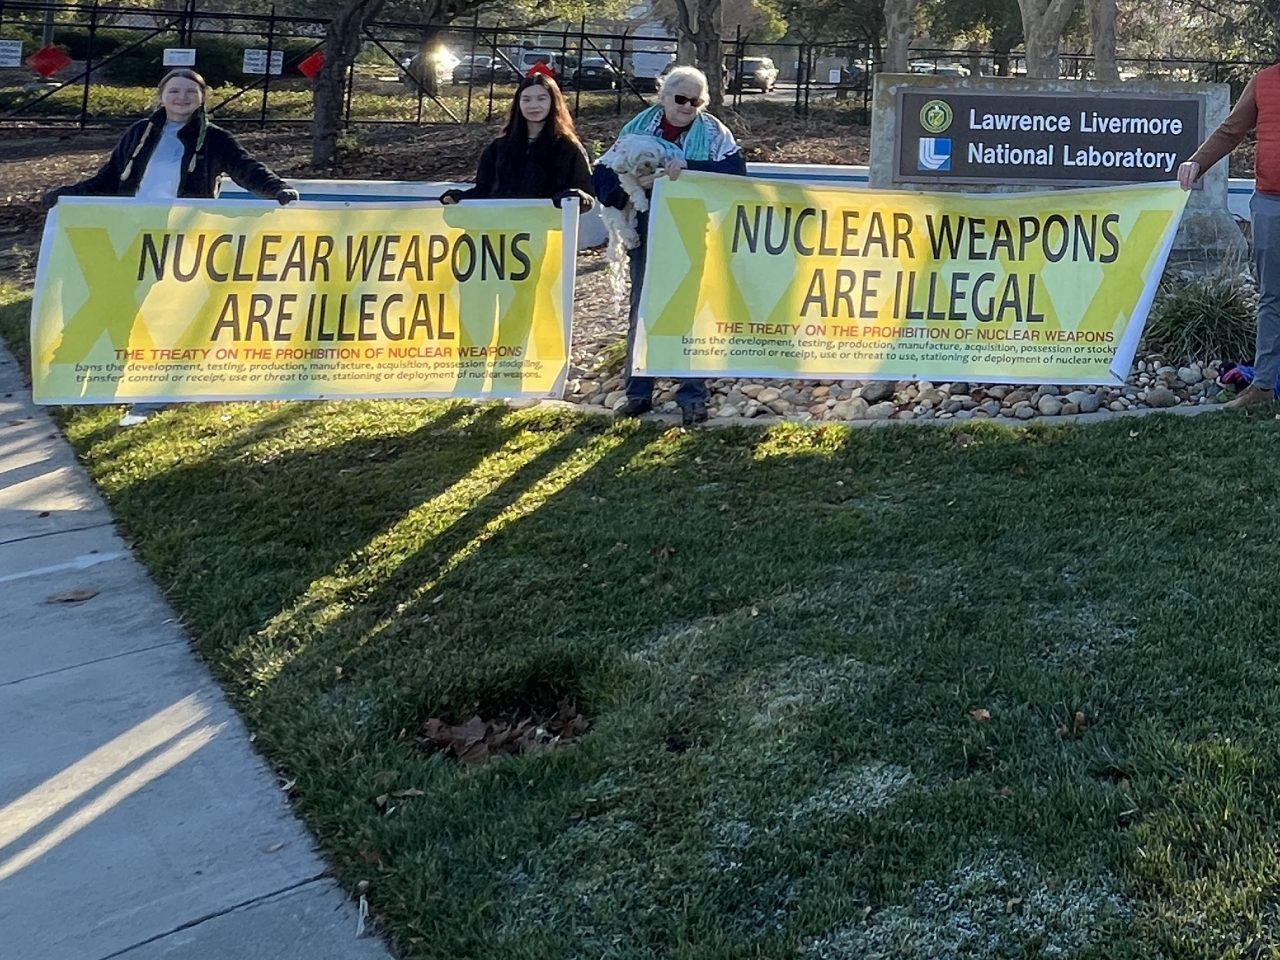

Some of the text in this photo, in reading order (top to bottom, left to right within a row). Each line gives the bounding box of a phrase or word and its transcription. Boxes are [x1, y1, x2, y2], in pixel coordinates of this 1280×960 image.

[969, 108, 1071, 132] Lawrence
[1080, 111, 1184, 135] Livermore
[967, 143, 1176, 173] National Laboratory
[731, 205, 1120, 263] NUCLEAR WEAPONS
[137, 232, 532, 282] NUCLEAR WEAPONS
[800, 268, 1044, 323] ARE ILLEGAL
[211, 293, 454, 341] ARE ILLEGAL
[716, 322, 1114, 342] THE TREATY ON THE PROHIBITION OF NUCLEAR WEAPONS
[114, 346, 522, 360] THE TREATY ON THE PROHIBITION OF NUCLEAR WEAPONS
[682, 336, 706, 344] bans
[709, 336, 726, 345] the
[729, 337, 795, 348] development,
[798, 339, 835, 349] testing,
[838, 340, 896, 350] production,
[898, 342, 962, 351] manufacture,
[965, 343, 1018, 353] acquisition,
[1020, 344, 1071, 354] possession
[683, 348, 727, 358] transfer,
[730, 349, 765, 357] control
[781, 350, 817, 360] receipt,
[853, 351, 883, 360] threat
[899, 354, 918, 362] use,
[920, 354, 969, 364] stationing
[985, 354, 1040, 365] deployment
[1043, 355, 1054, 363] of
[1056, 355, 1091, 364] nuclear
[75, 363, 102, 372] bans
[105, 363, 125, 372] the
[128, 362, 203, 373] development,
[207, 362, 246, 373] testing,
[250, 361, 307, 373] production,
[310, 361, 373, 371] manufacture,
[377, 360, 431, 371] acquisition,
[434, 360, 484, 370] possession
[128, 373, 168, 381] control
[186, 373, 226, 382] receipt,
[264, 372, 295, 381] threat
[298, 373, 308, 381] to
[311, 374, 330, 382] use,
[333, 371, 381, 382] stationing
[397, 371, 454, 381] deployment
[457, 371, 467, 379] of
